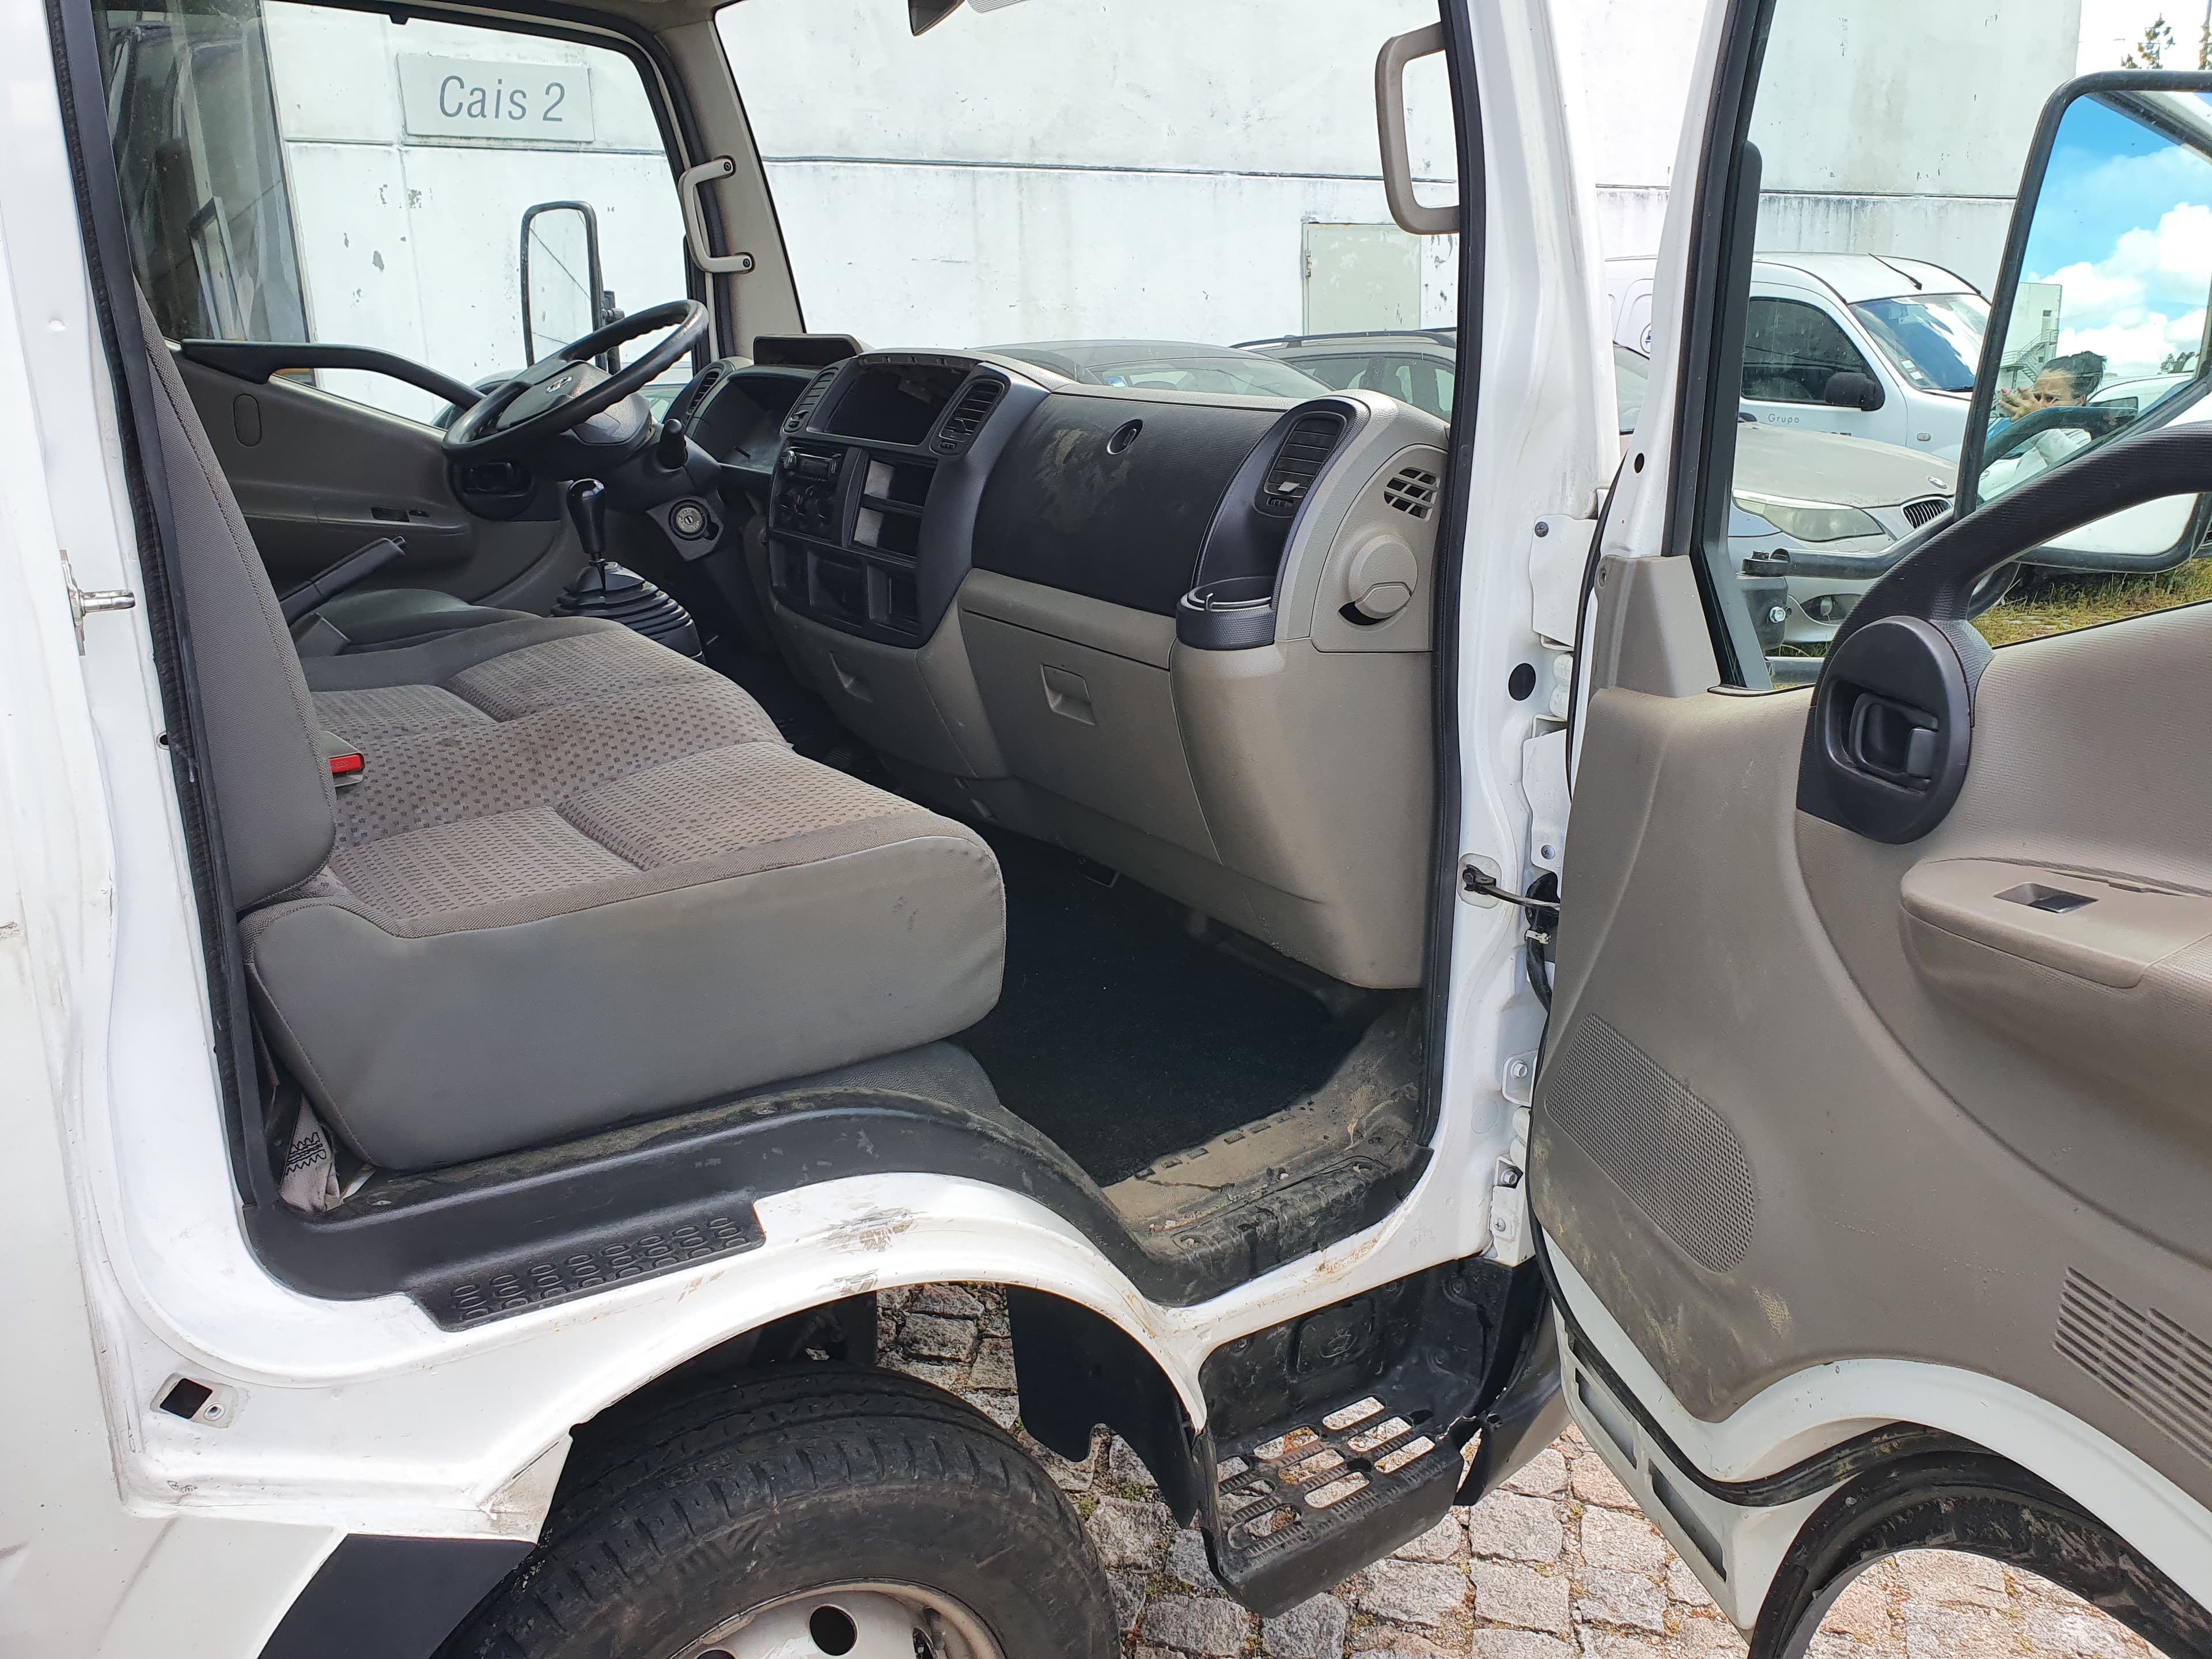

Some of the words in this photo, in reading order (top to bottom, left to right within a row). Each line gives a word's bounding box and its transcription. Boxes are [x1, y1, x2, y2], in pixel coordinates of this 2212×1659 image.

[439, 75, 527, 120] Cais
[542, 82, 566, 122] 2
[1768, 414, 1800, 425] Grupo
